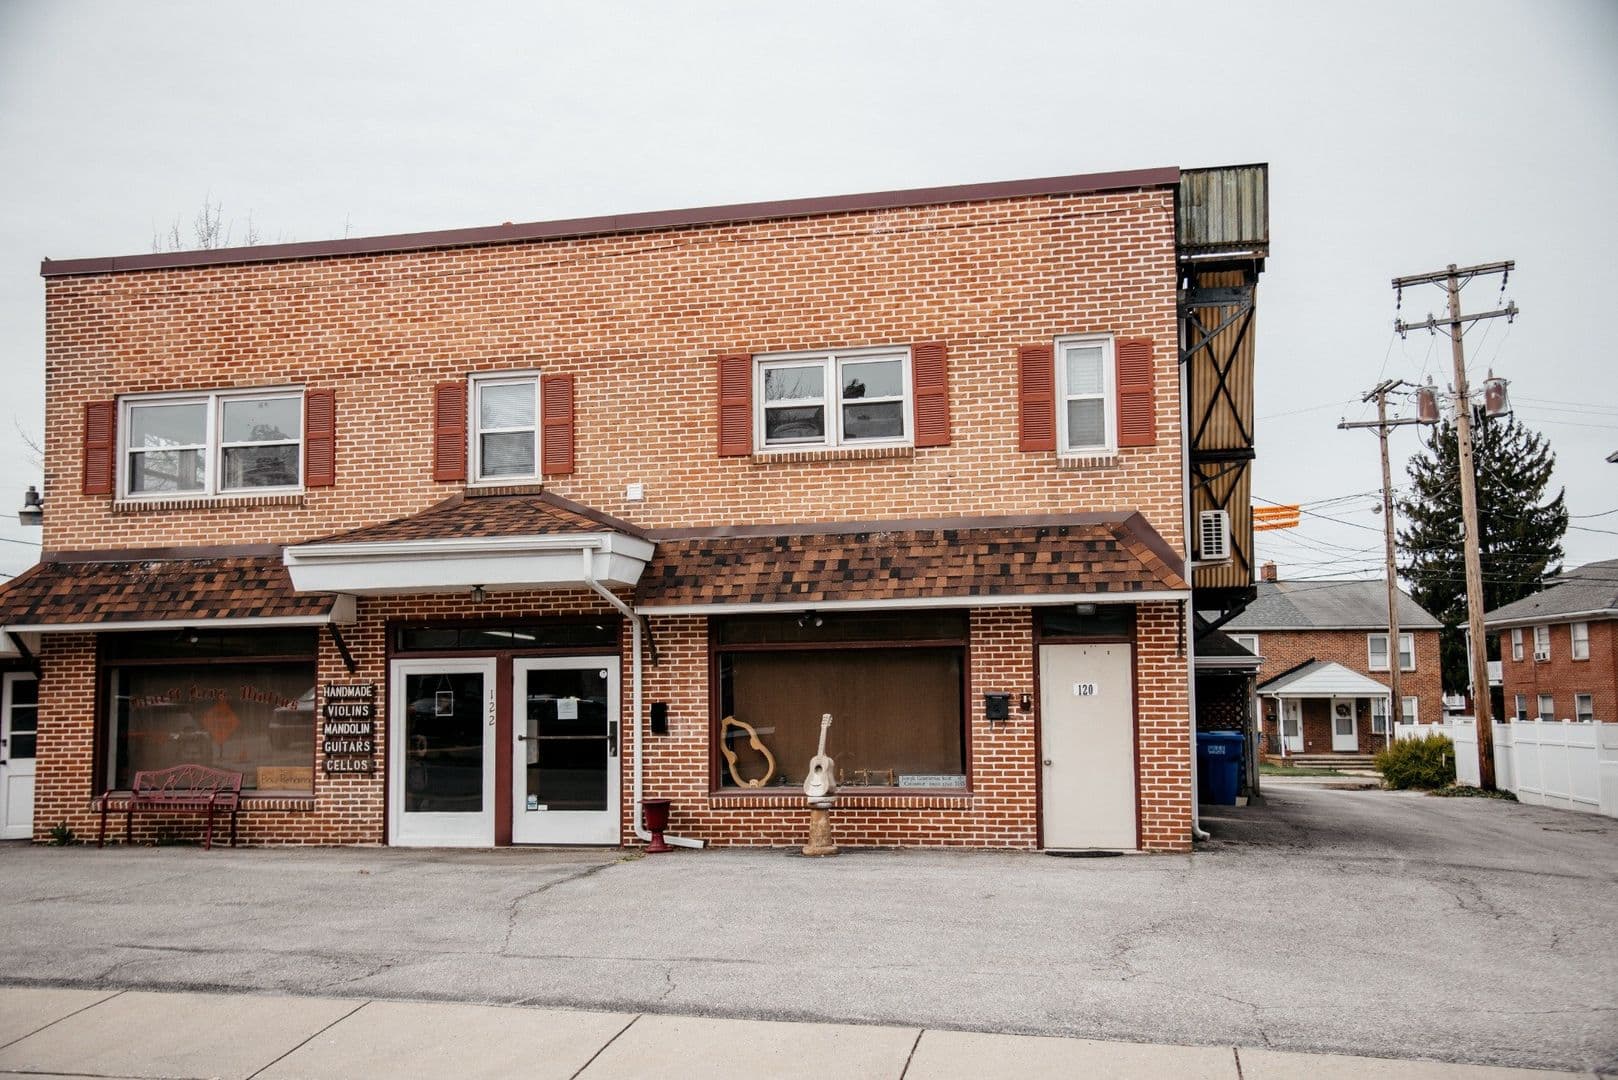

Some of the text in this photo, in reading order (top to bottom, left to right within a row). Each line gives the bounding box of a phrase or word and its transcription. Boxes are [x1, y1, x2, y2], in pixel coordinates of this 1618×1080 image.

[323, 686, 372, 697] HANDMADE
[1078, 684, 1093, 696] 120
[328, 705, 369, 716] VIOLINS
[324, 723, 370, 735] MANDOLIN
[324, 741, 370, 753] GUITARS
[326, 760, 368, 771] CELLOS
